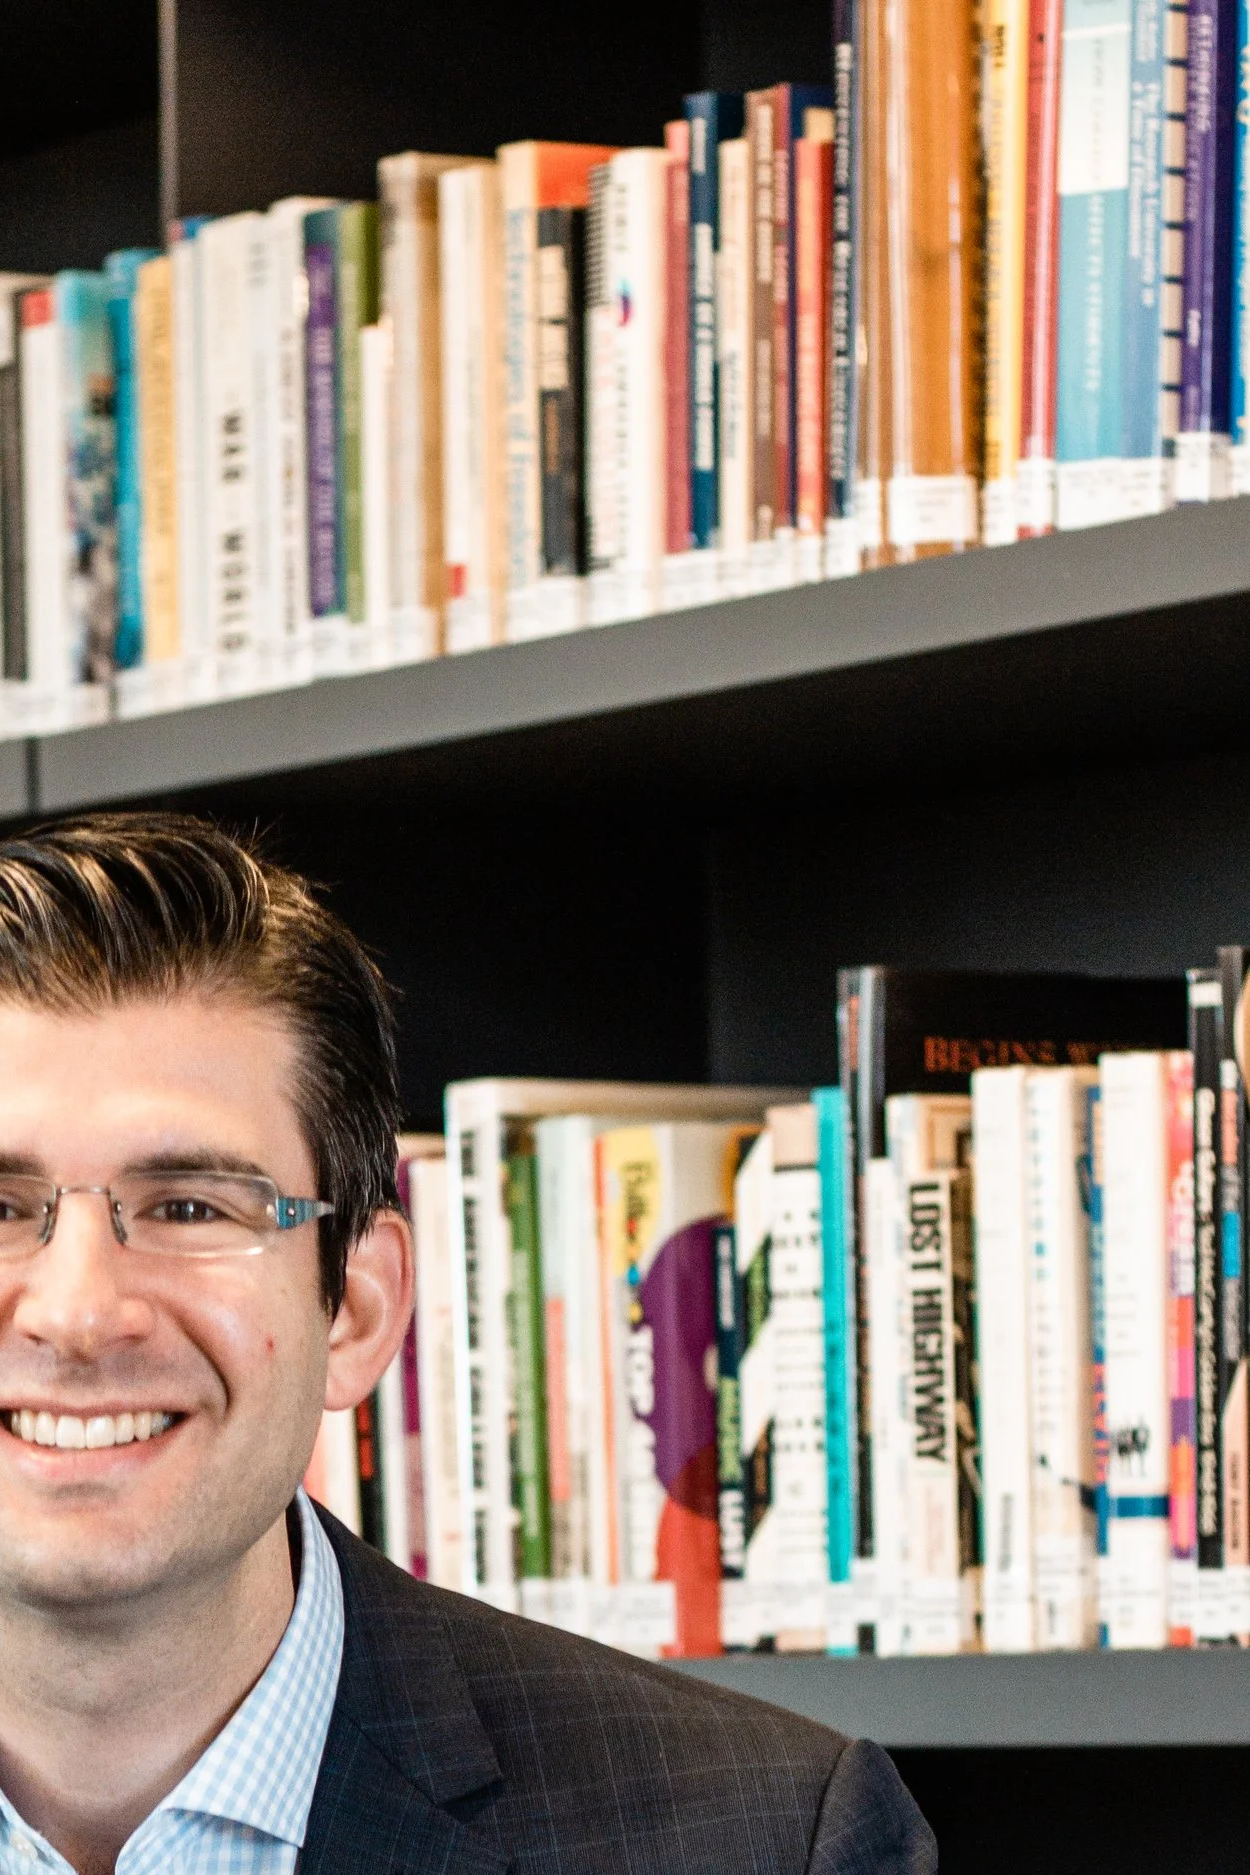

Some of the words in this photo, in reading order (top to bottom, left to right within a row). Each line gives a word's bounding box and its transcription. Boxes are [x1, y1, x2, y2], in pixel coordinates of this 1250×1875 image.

[909, 1182, 943, 1271] LOST
[630, 1326, 655, 1416] TOP
[912, 1287, 947, 1463] HIGHWAY
[718, 1375, 742, 1482] MUSIC
[719, 1488, 745, 1567] LUST
